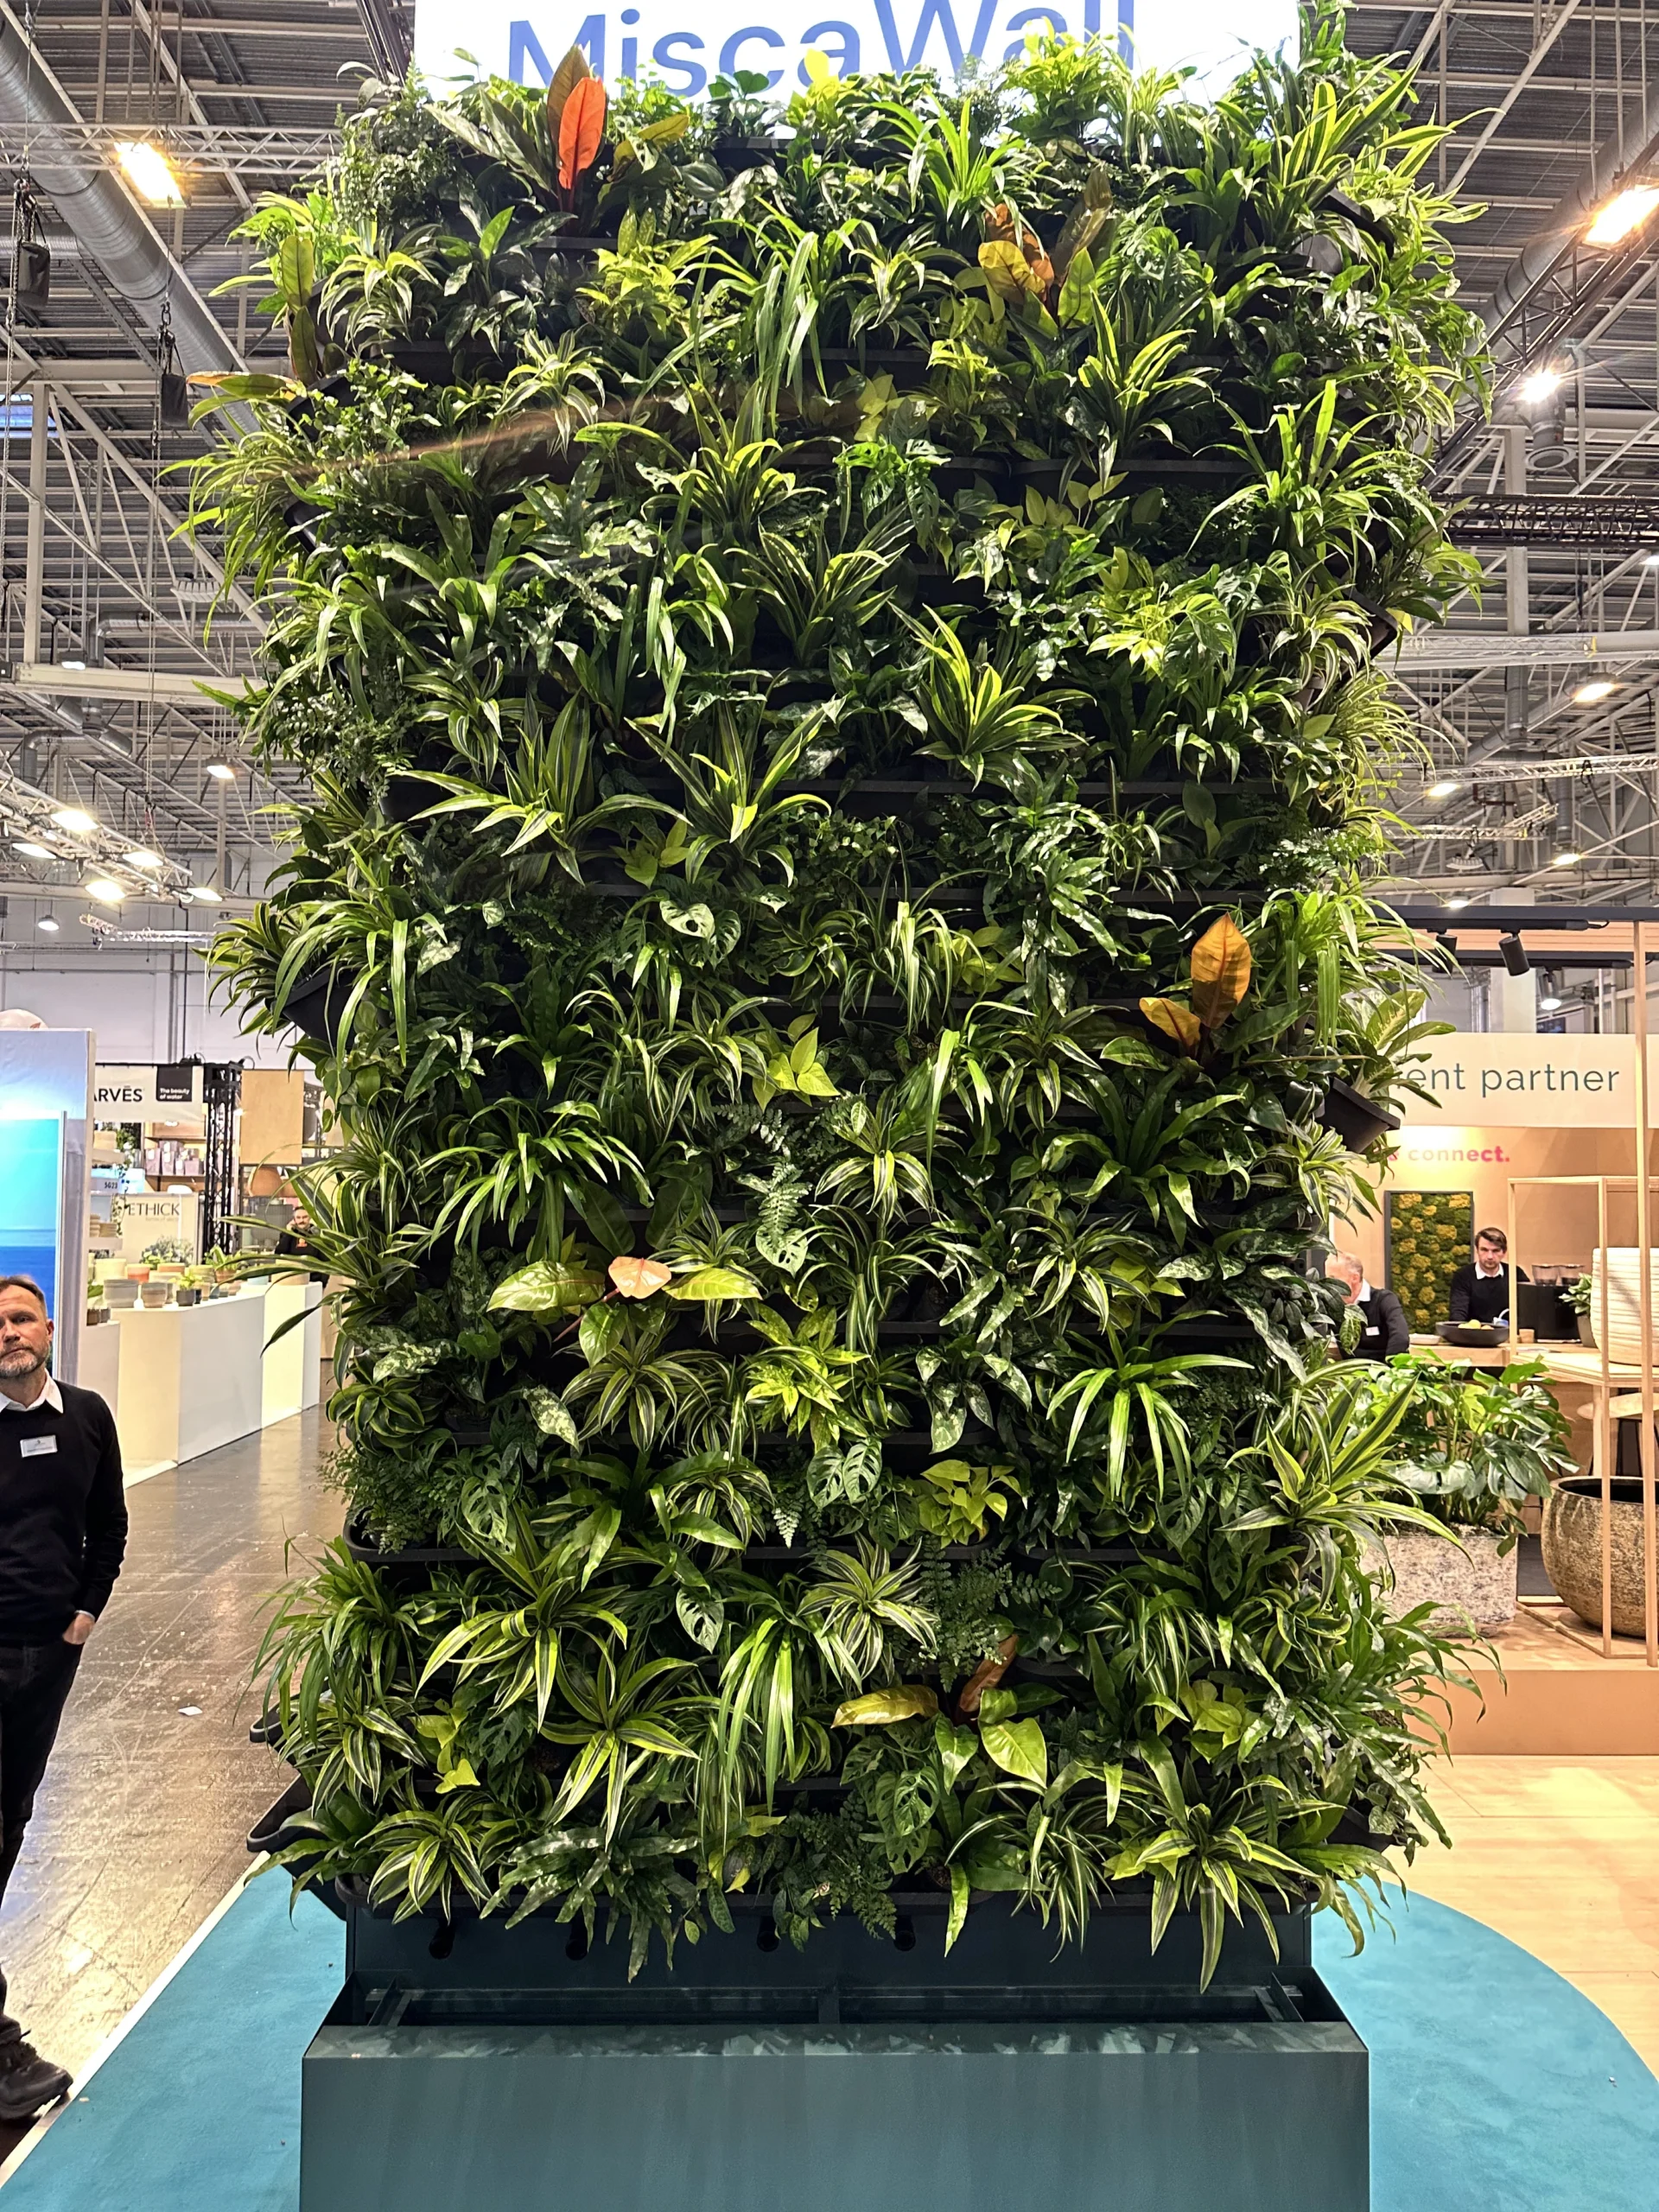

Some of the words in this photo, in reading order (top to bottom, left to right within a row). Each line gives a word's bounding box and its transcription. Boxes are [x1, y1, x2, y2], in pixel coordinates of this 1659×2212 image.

[1396, 1063, 1466, 1090] ent
[1482, 1064, 1619, 1098] partner
[94, 1085, 143, 1103] RVĒS
[1408, 1146, 1510, 1163] connect.
